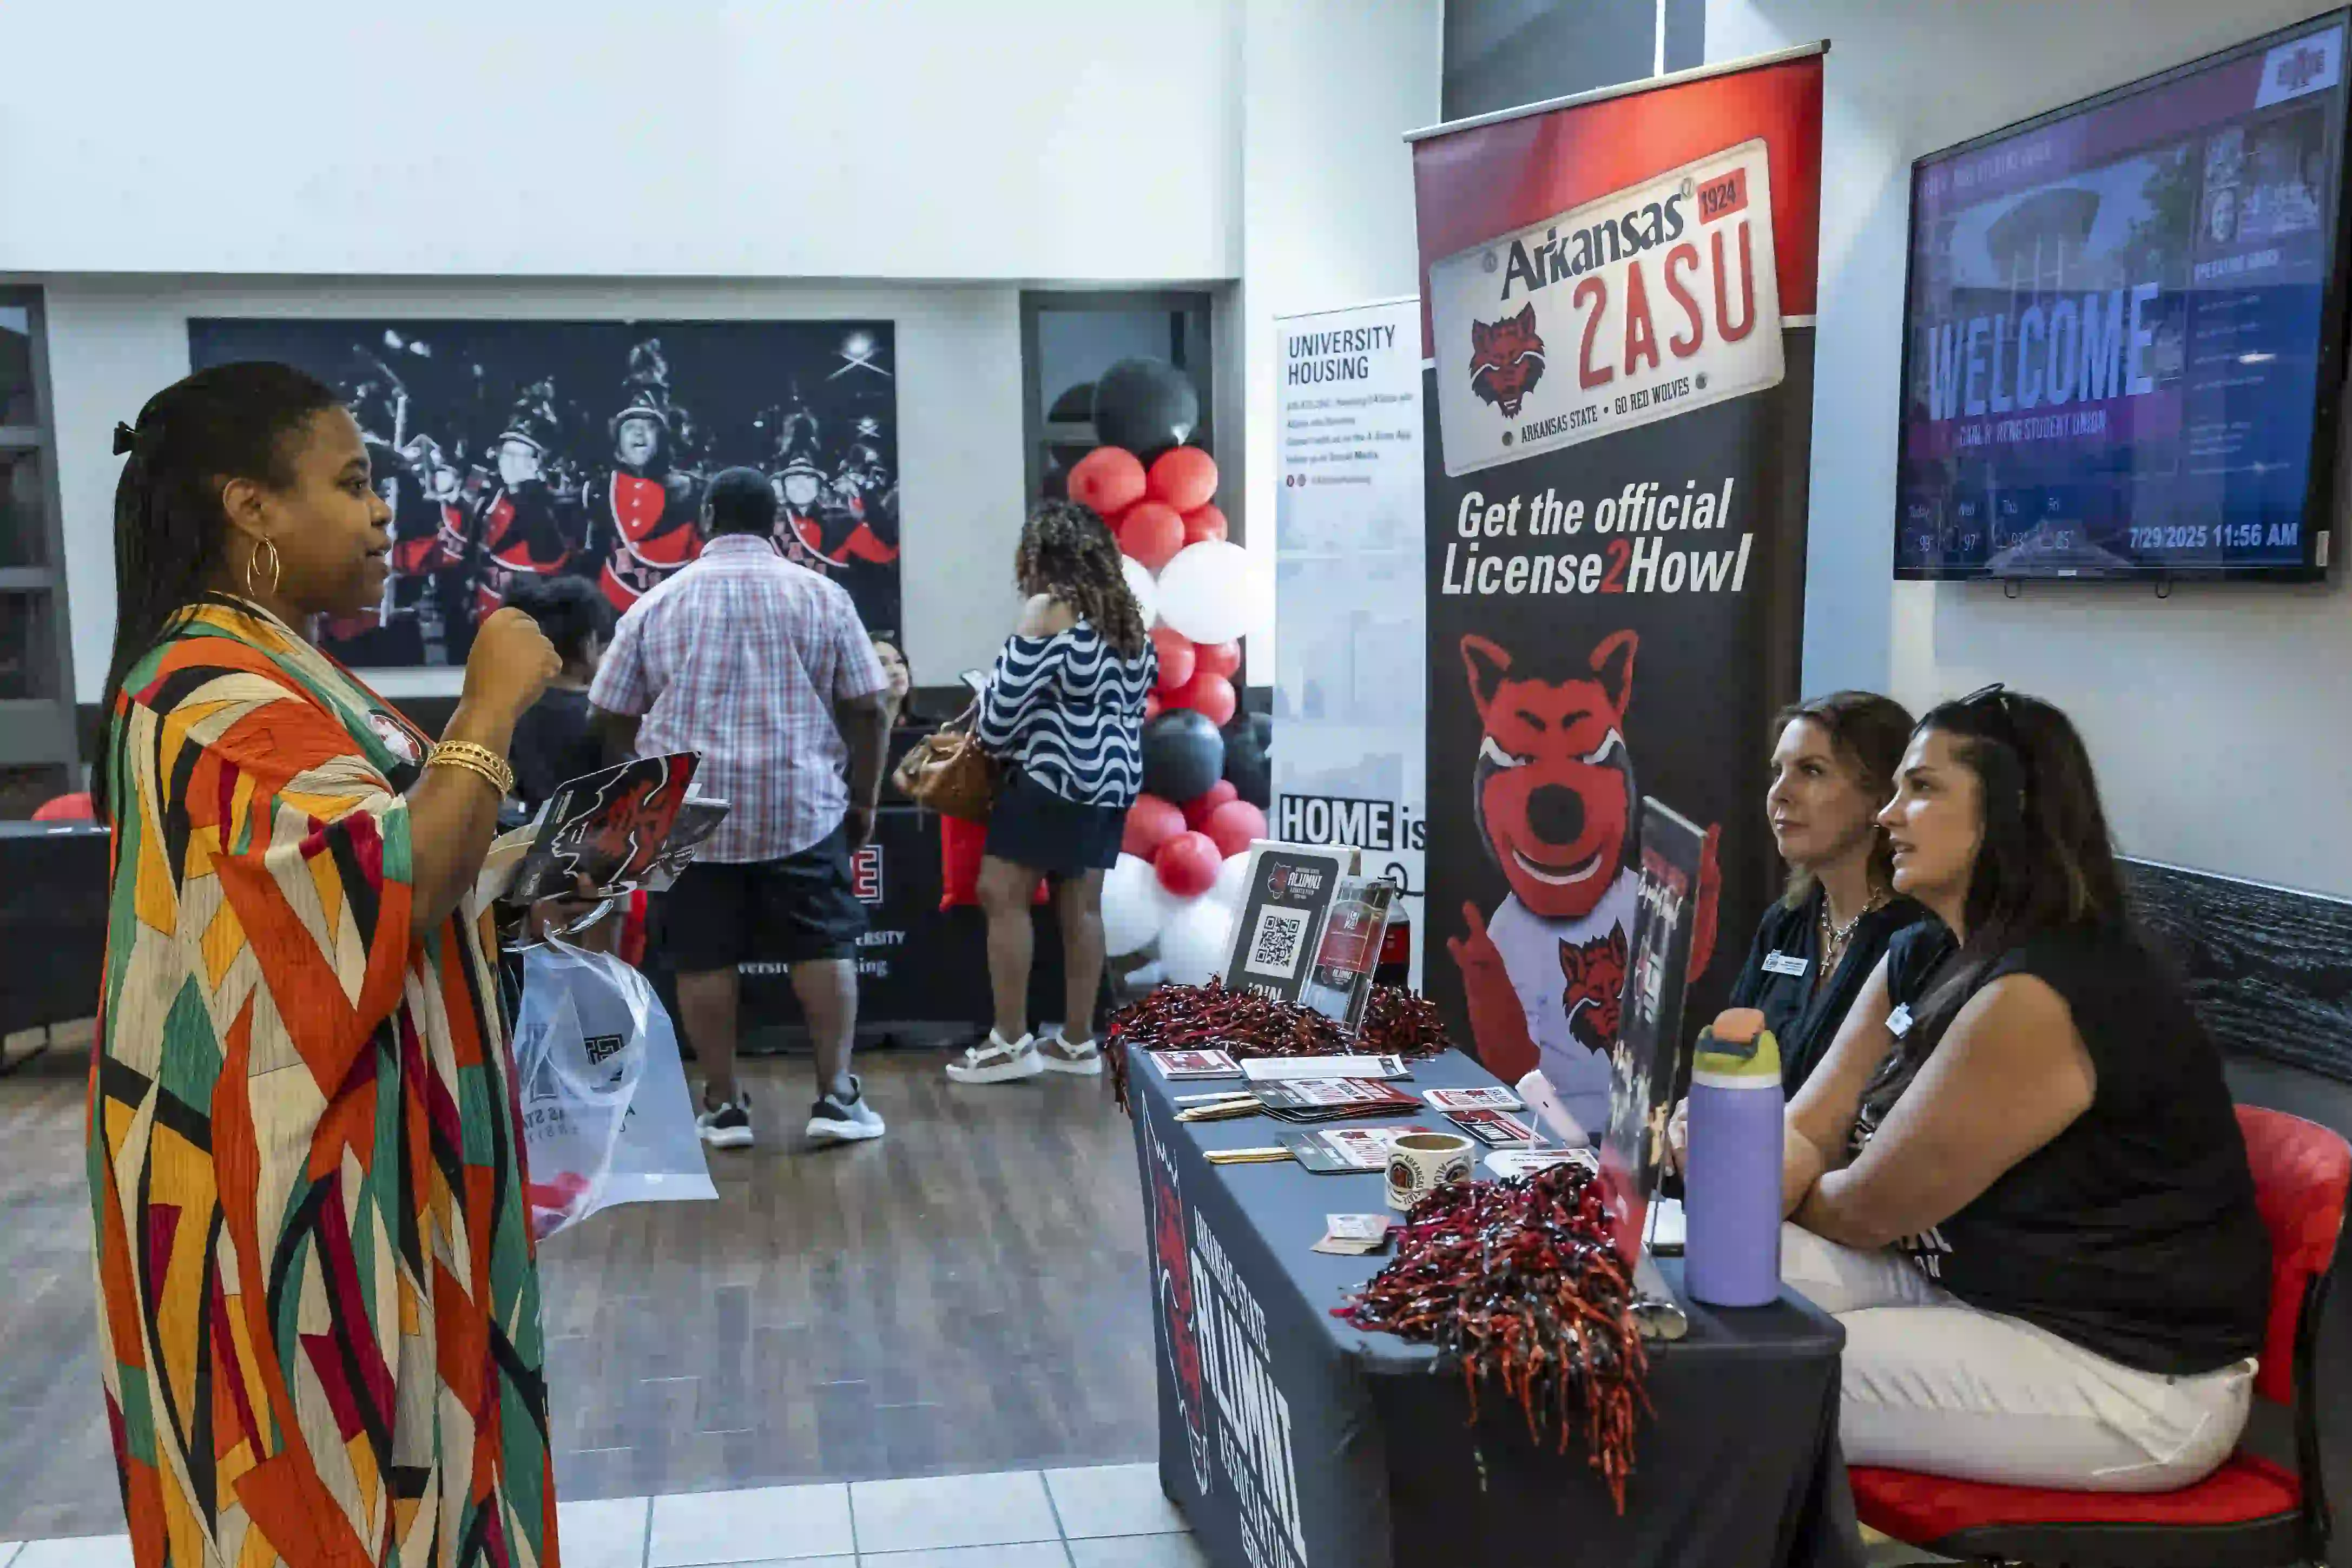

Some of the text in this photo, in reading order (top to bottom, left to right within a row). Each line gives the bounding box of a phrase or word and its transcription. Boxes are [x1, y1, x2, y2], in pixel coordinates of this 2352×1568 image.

[1701, 179, 1736, 216] 1924
[1501, 193, 1683, 300] Arkansas
[1573, 221, 1755, 390] 2ASU
[1288, 357, 1368, 385] HOUSING
[1289, 325, 1395, 358] UNIVERSITY
[1929, 281, 2158, 421] WELCOME
[1521, 378, 1689, 443] ARKANSAS STATE GO RED WOLVES
[2025, 413, 2070, 439] STUDENT
[1458, 477, 1734, 537] Get the official
[2213, 524, 2262, 546] 11:56
[2266, 523, 2298, 546] AM
[1442, 533, 1753, 594] License2Howl
[1281, 796, 1425, 851] HOME is
[1235, 1273, 1271, 1363] STATE
[1191, 1247, 1308, 1568] ALUMNI
